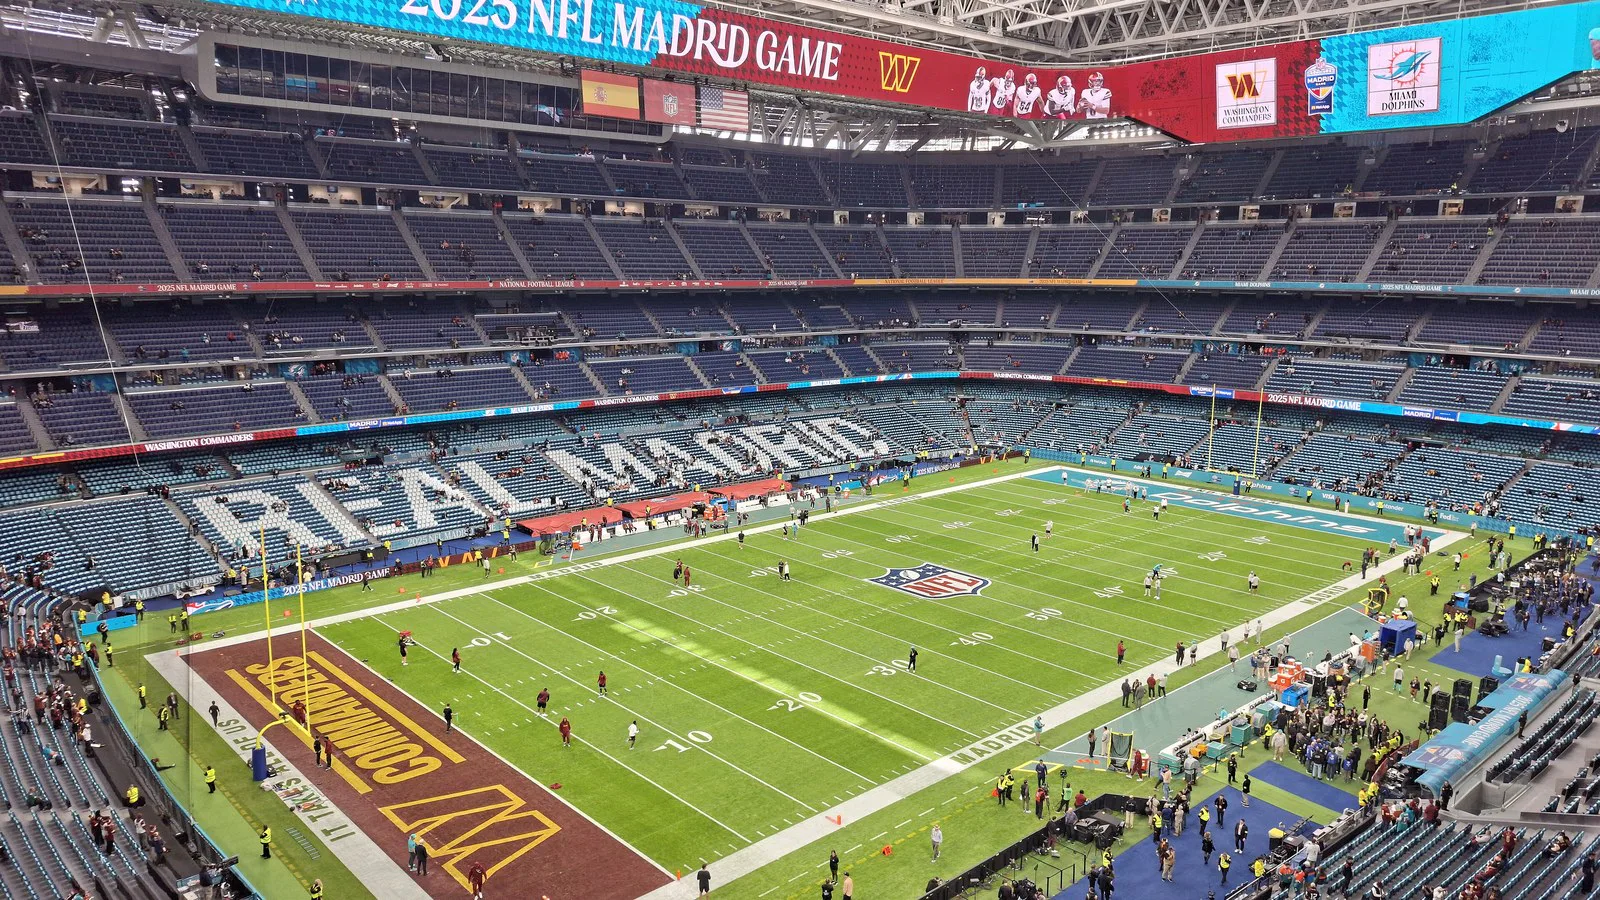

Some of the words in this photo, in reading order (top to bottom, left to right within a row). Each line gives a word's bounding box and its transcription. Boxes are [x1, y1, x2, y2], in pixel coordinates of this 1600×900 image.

[528, 2, 603, 45] NFL
[611, 7, 750, 68] MADRID
[755, 30, 843, 80] GAME
[1307, 75, 1335, 84] MADRID
[1388, 90, 1418, 101] MIAMI
[1019, 101, 1032, 112] 54
[1223, 105, 1270, 117] WASHINGTON
[1381, 100, 1425, 111] DOLPHINS
[1222, 113, 1272, 125] COMMANDERS
[157, 284, 176, 292] 2025
[190, 283, 217, 292] MADRID
[217, 283, 237, 291] GAME
[555, 280, 575, 288] LEAGUE
[1405, 284, 1426, 292] MADRID
[1570, 288, 1589, 296] MIAMI
[993, 372, 1023, 380] WASHINGTON
[593, 398, 627, 406] WASHINGTON
[626, 394, 660, 403] COMMANDERS
[1267, 393, 1288, 404] 2025
[1288, 396, 1303, 405] NFL
[1303, 397, 1336, 408] MADRID
[1336, 400, 1361, 411] GAME
[1403, 410, 1432, 418] MADRID
[349, 420, 379, 428] MADRID
[144, 439, 199, 452] WASHINGTON
[200, 433, 254, 446] COMMANDERS
[193, 455, 580, 552] REAL
[545, 416, 890, 492] MADRID
[1149, 492, 1378, 534] Dolphins
[527, 561, 603, 580] MADRID
[283, 584, 308, 596] 2025
[308, 580, 327, 592] NFL
[327, 572, 364, 588] MADRID
[902, 573, 980, 597] NFL
[136, 584, 171, 601] MIAMI
[1299, 584, 1350, 607] MADRID
[577, 605, 618, 621] 20
[1025, 607, 1064, 622] 50
[470, 631, 513, 647] 10
[958, 631, 995, 647] 40
[872, 657, 910, 677] 30
[775, 691, 823, 713] 20
[217, 717, 247, 735] US
[245, 655, 442, 785] COMMANDERS
[666, 729, 714, 754] 10
[949, 724, 1036, 766] MADRID
[321, 823, 356, 843] IT
